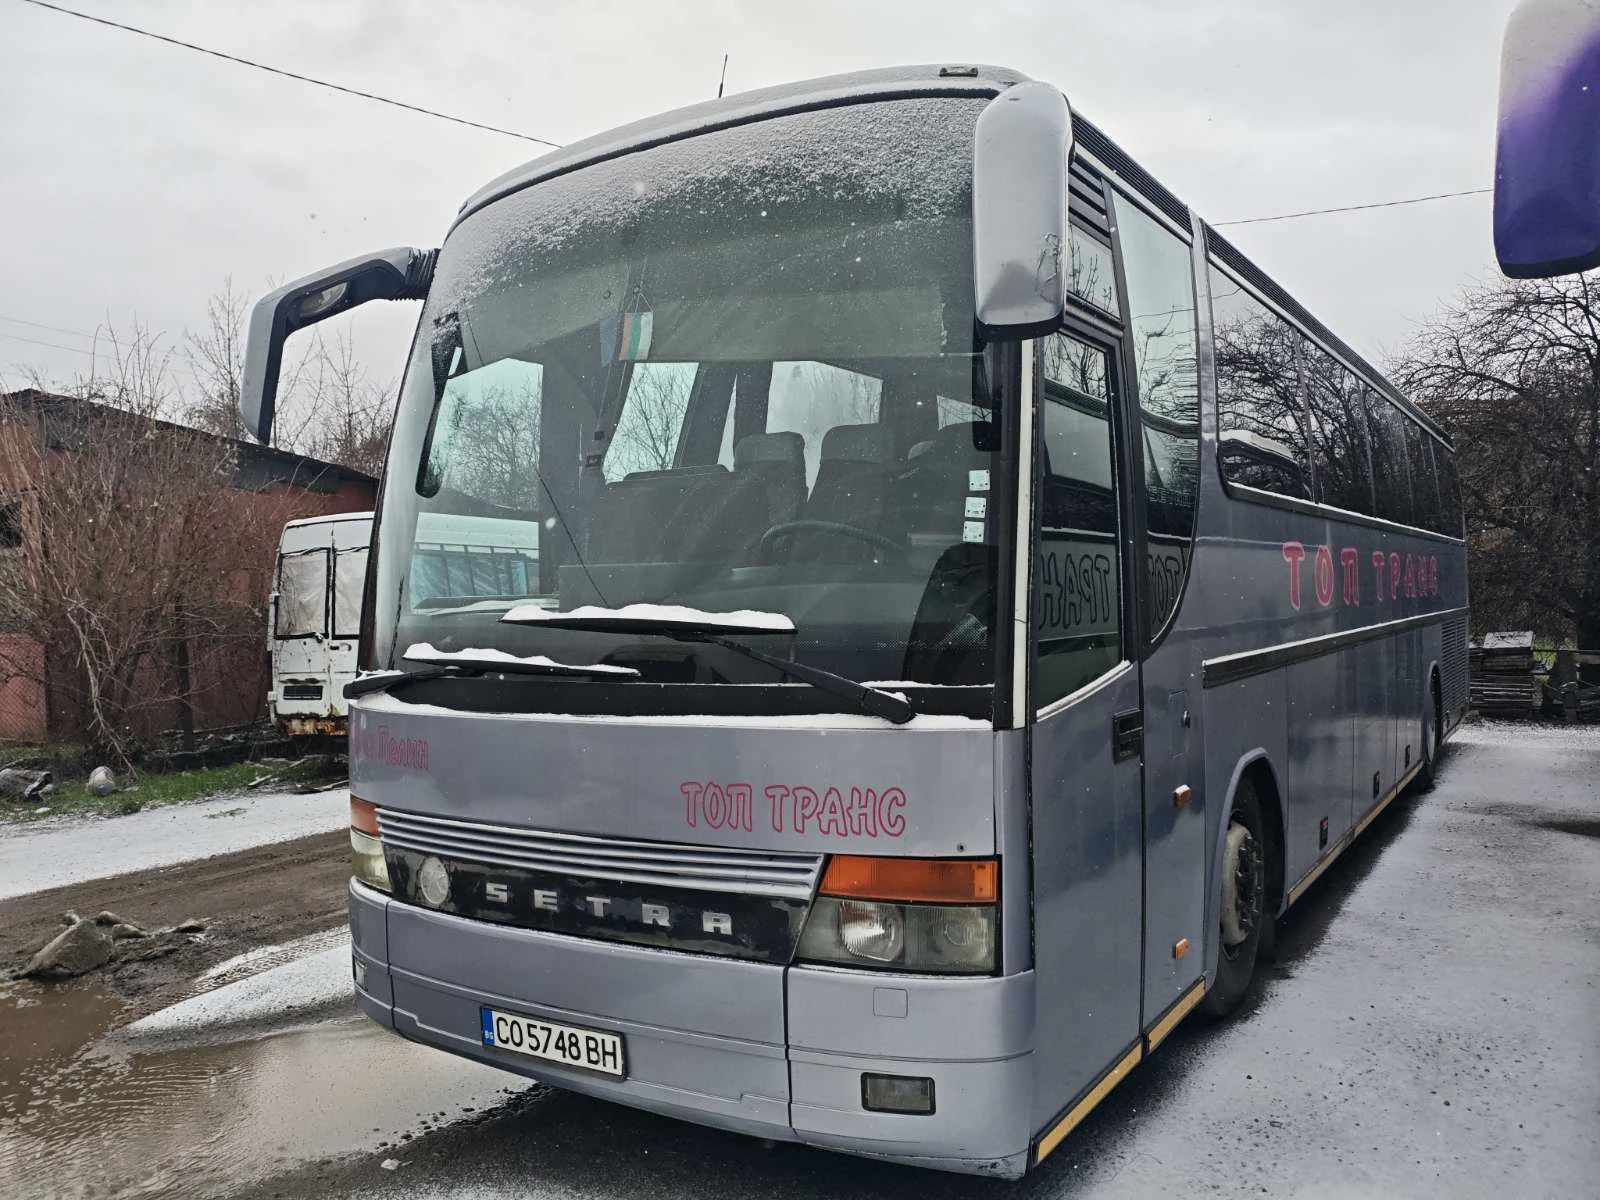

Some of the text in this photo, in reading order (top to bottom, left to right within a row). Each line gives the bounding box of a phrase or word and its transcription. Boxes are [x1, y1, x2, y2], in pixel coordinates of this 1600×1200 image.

[1282, 541, 1438, 609] ТОП ТРАНС
[680, 781, 906, 837] ТОП ТРАНС
[485, 882, 733, 935] SETRA
